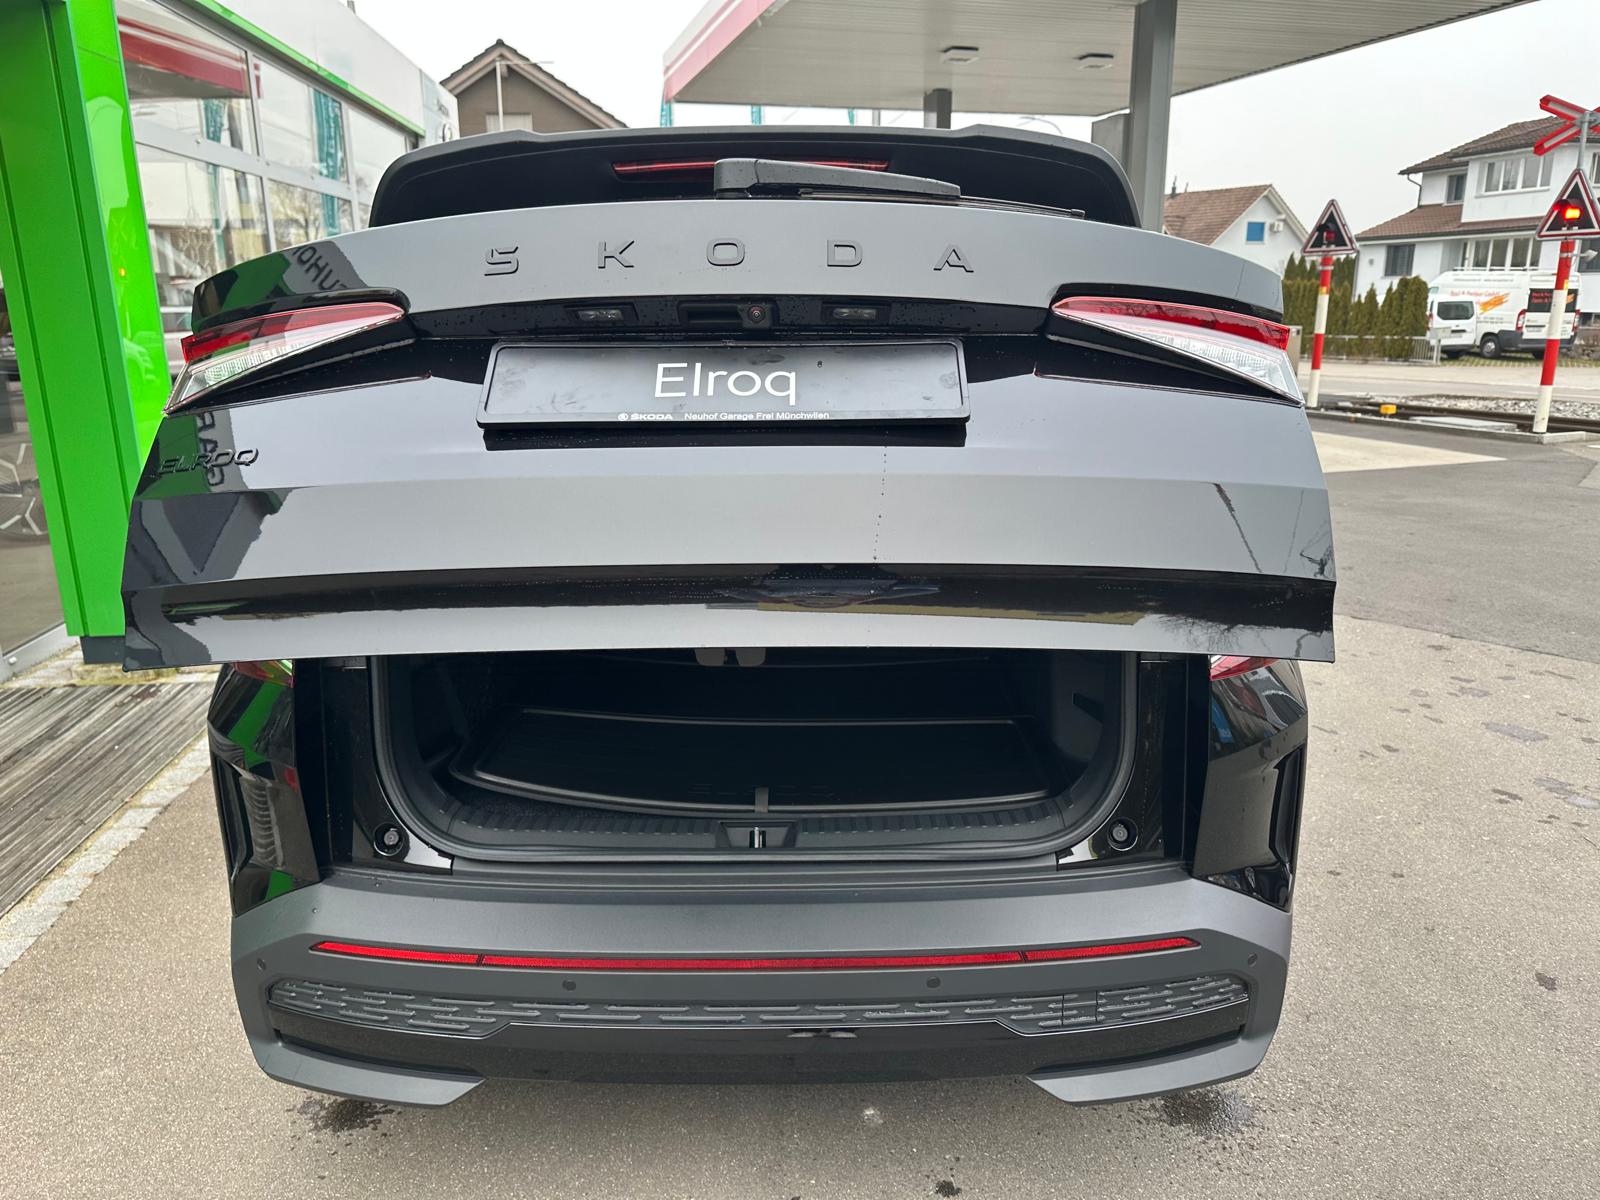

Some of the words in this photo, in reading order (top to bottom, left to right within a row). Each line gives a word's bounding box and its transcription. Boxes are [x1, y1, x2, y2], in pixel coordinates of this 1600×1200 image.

[654, 362, 796, 406] Elroq
[684, 412, 719, 420] Neuhof
[720, 412, 754, 421] Garage
[756, 412, 774, 420] Frei
[776, 411, 830, 420] Münchwilen
[159, 448, 259, 475] ELROQ
